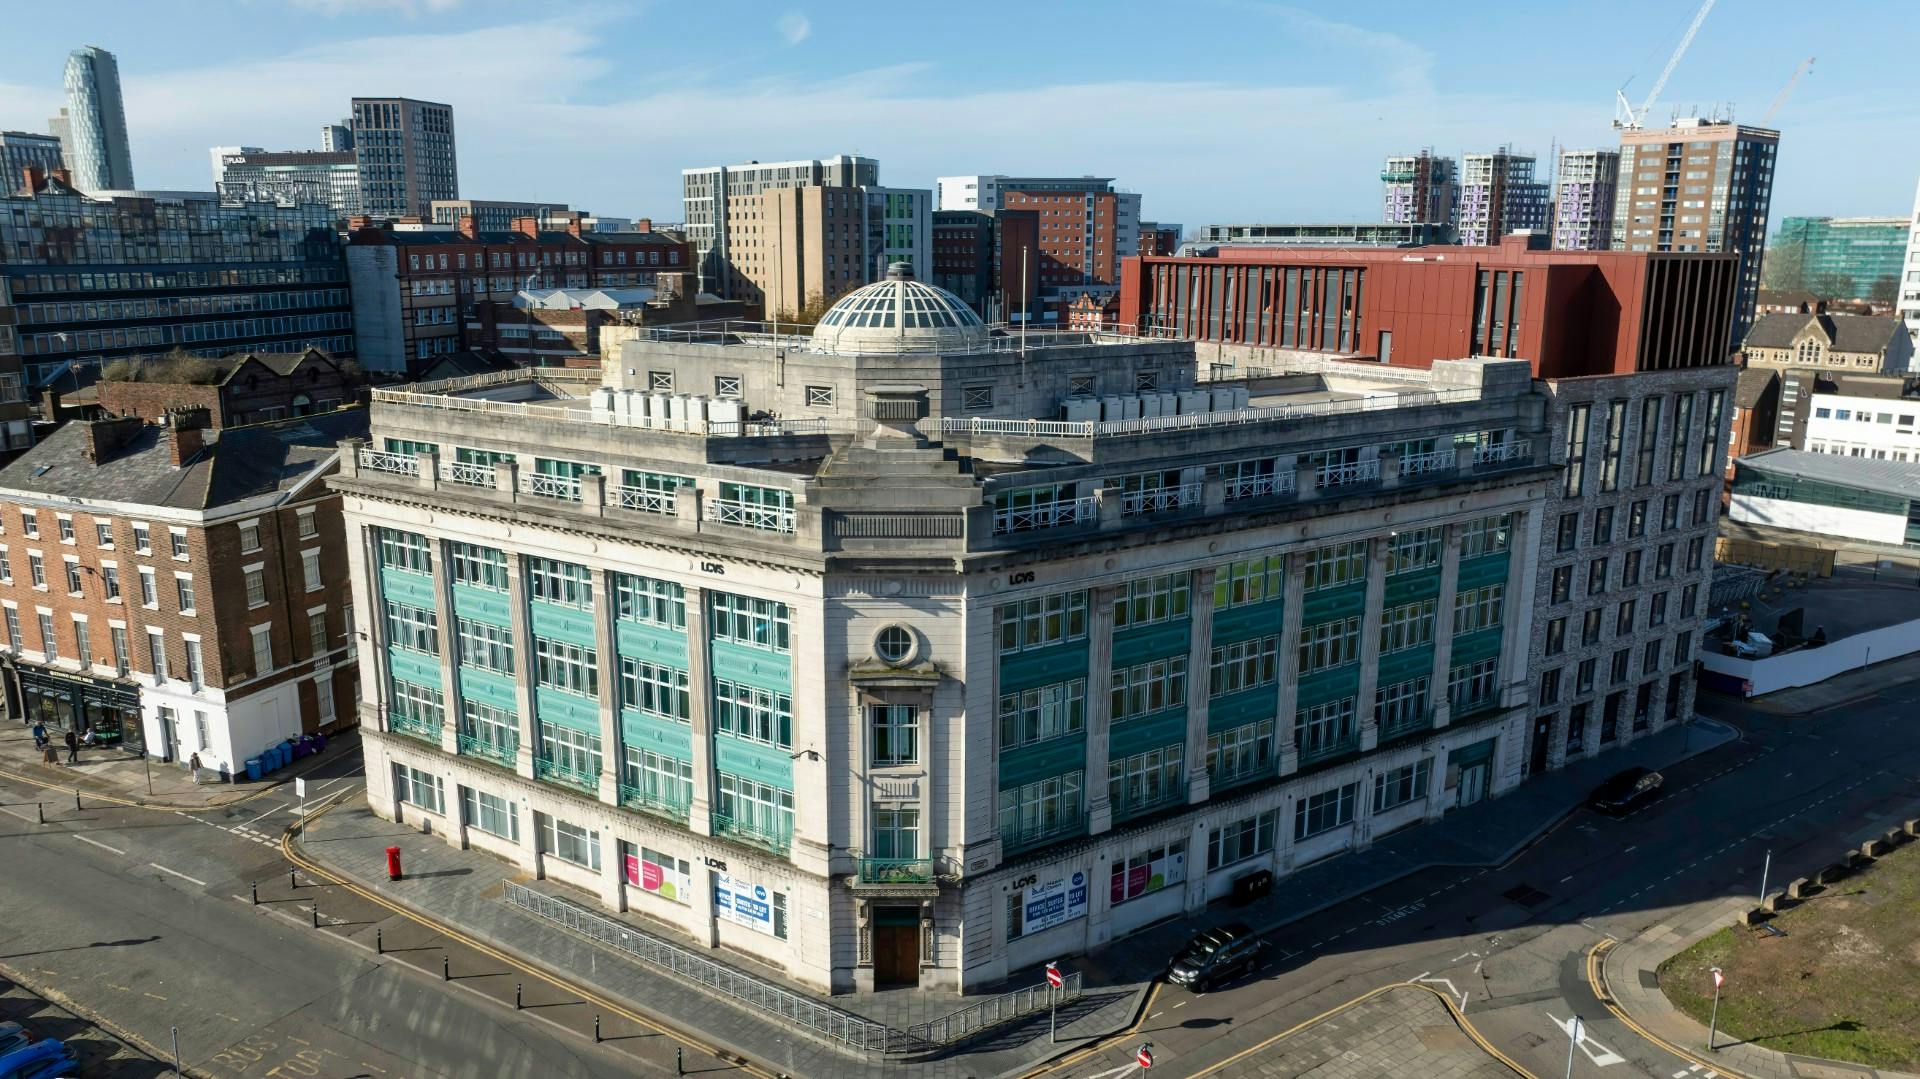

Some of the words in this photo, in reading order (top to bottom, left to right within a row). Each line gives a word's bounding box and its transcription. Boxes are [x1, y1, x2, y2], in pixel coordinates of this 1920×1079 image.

[228, 156, 246, 164] PLAZA
[701, 561, 725, 575] LCVS
[1009, 571, 1035, 585] LCVS
[704, 856, 727, 871] LCVS
[1013, 874, 1037, 889] LCVS
[1047, 897, 1063, 907] SUITES
[1075, 889, 1083, 898] LET
[212, 1035, 278, 1072] BUS
[262, 1050, 322, 1079] TOP
